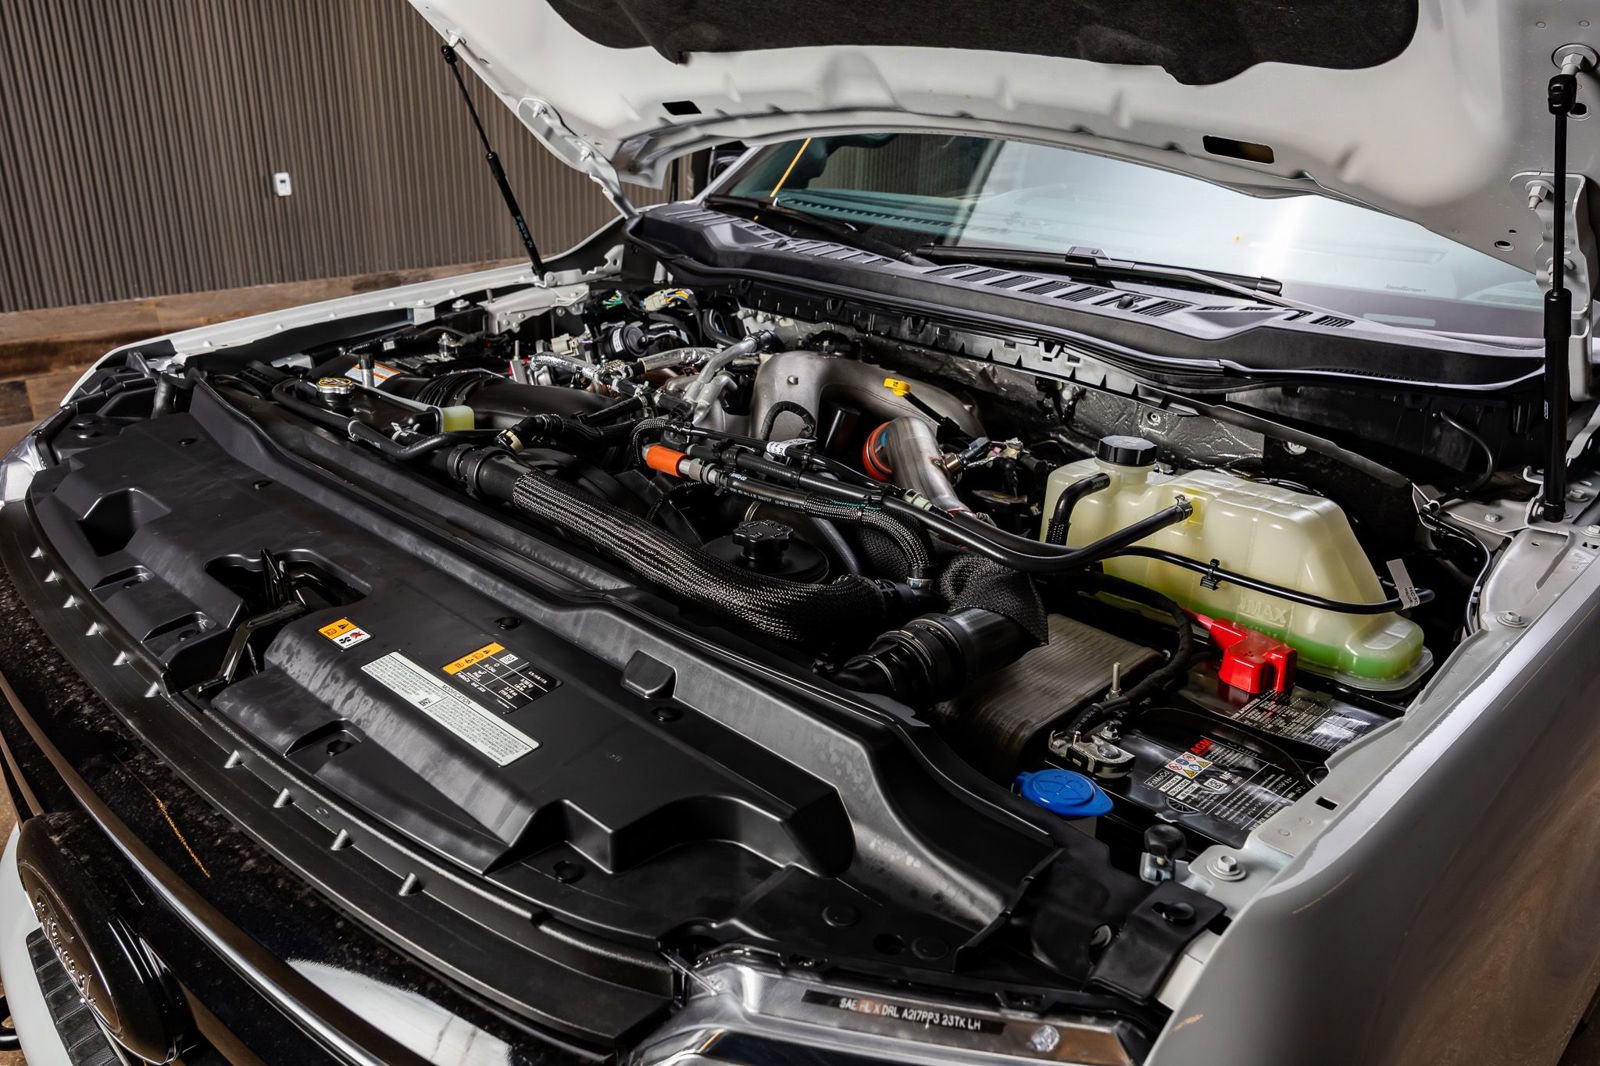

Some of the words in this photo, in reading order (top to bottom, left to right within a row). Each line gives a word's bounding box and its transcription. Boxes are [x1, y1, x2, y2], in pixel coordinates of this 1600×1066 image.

[442, 684, 473, 705] MODIFICATION
[1190, 738, 1213, 754] AGM
[839, 998, 857, 1010] SAE
[881, 1005, 899, 1018] DRL
[967, 1018, 981, 1031] LH
